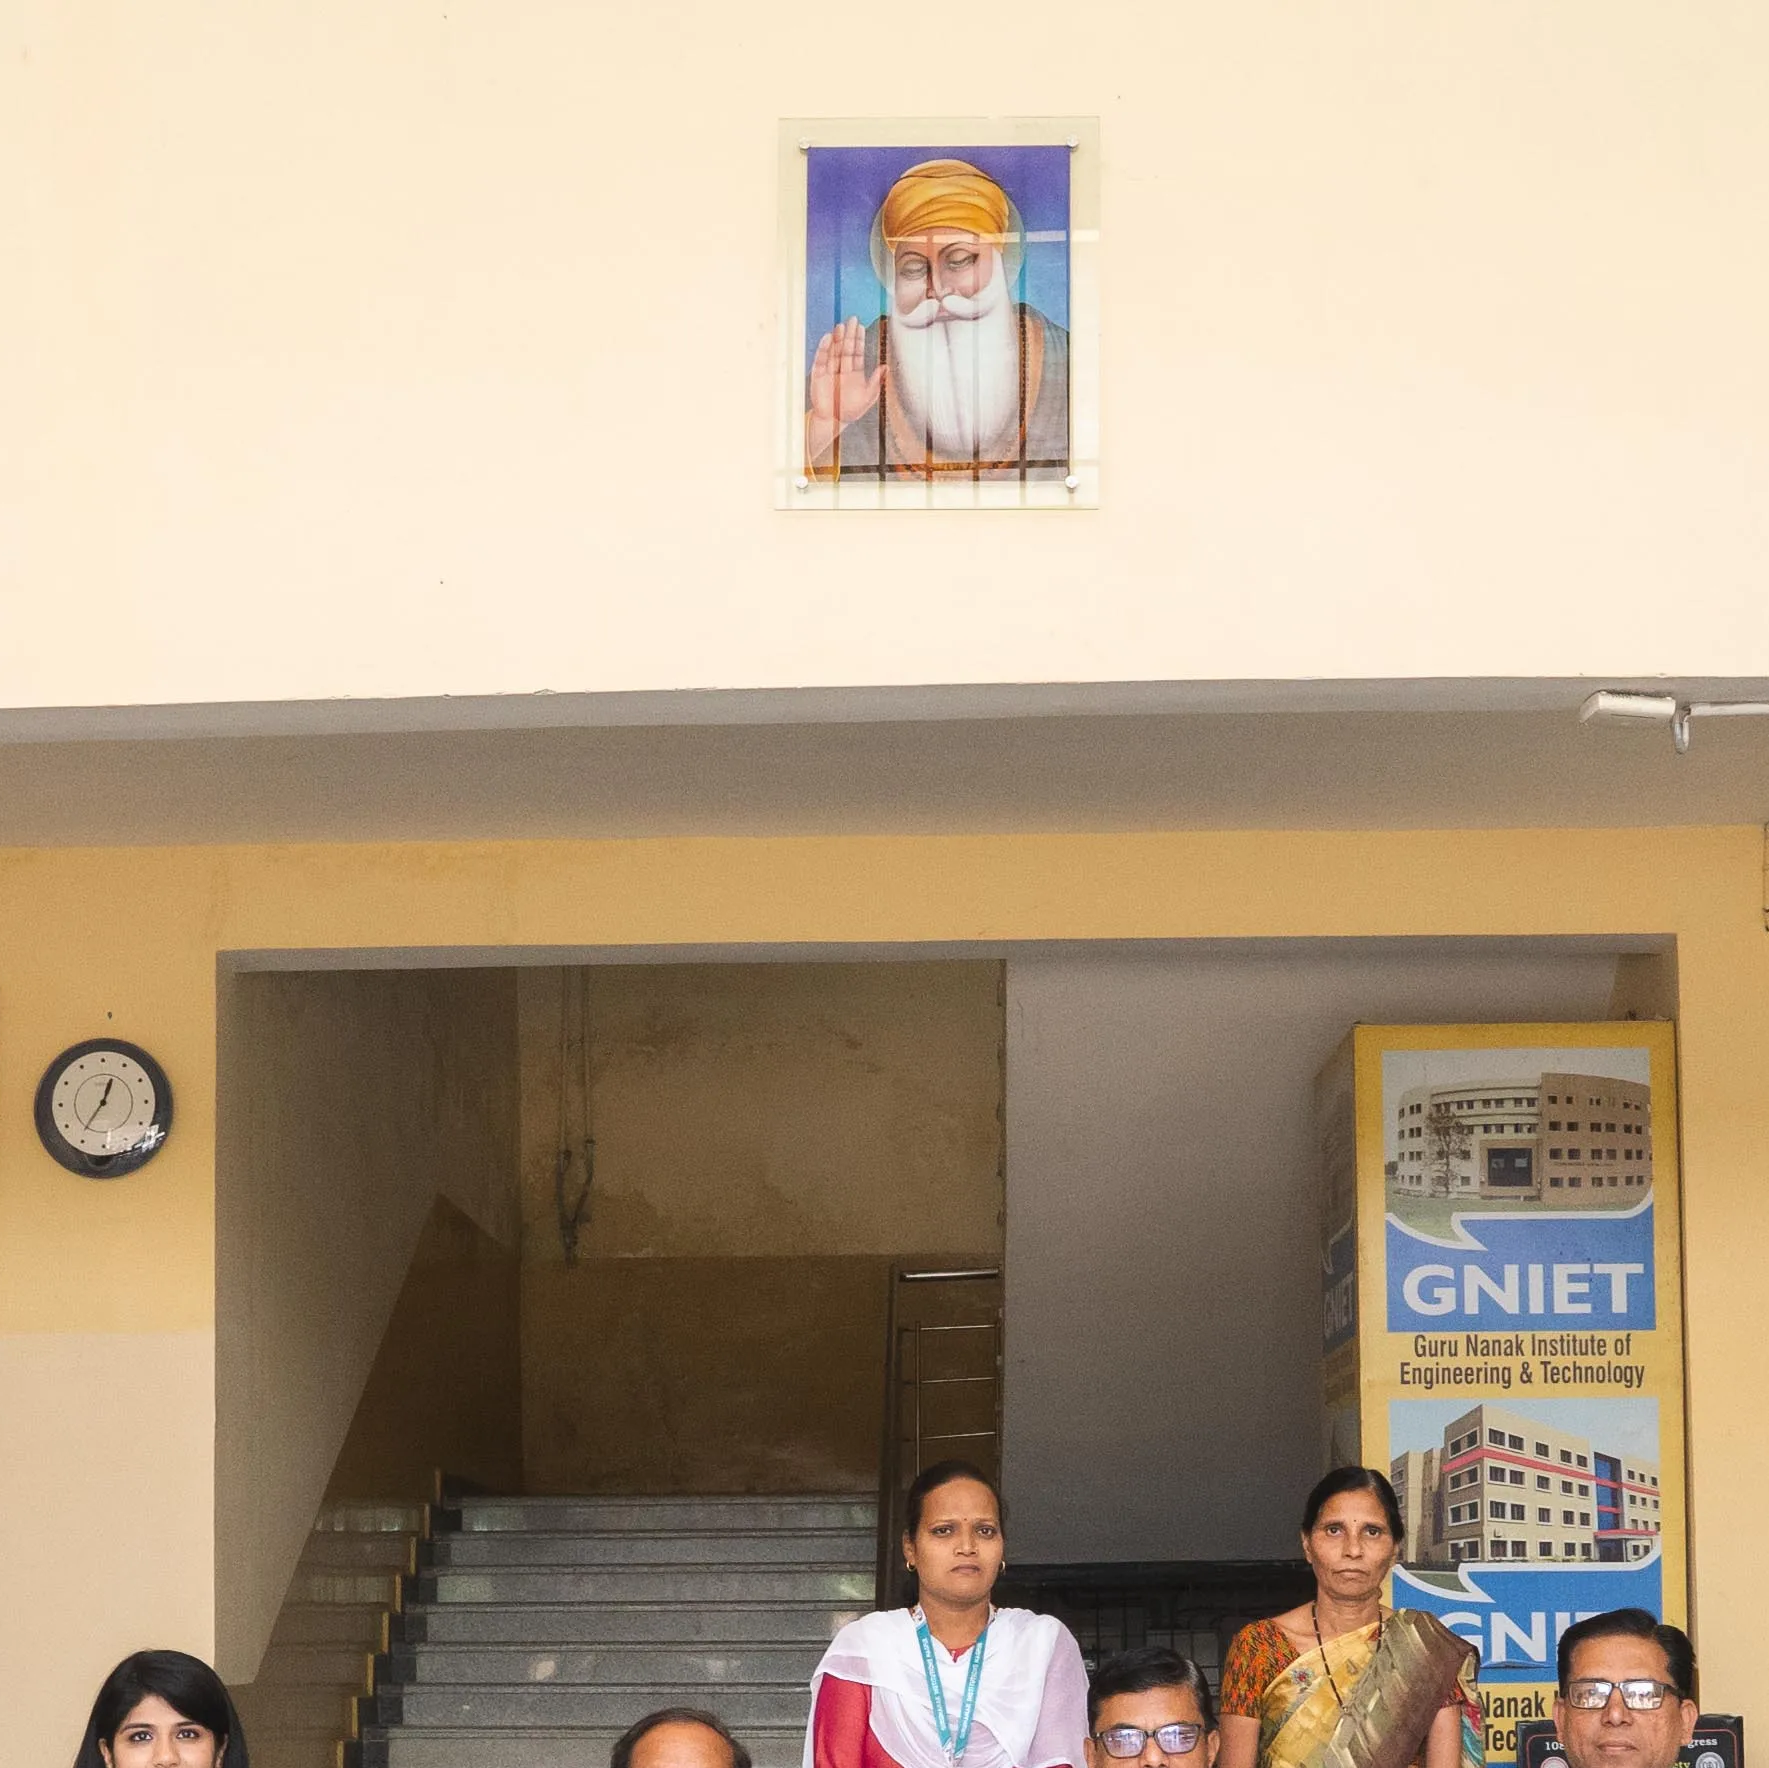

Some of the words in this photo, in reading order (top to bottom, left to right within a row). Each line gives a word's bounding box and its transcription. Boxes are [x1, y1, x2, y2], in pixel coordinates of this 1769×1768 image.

[1403, 1263, 1644, 1316] GNIET
[1414, 1334, 1458, 1357] Guru
[1466, 1334, 1525, 1357] Nanak
[1531, 1333, 1607, 1356] Institute
[1614, 1333, 1632, 1356] of
[1400, 1361, 1511, 1390] Engineering
[1520, 1361, 1533, 1384] &
[1540, 1360, 1645, 1388] Technology
